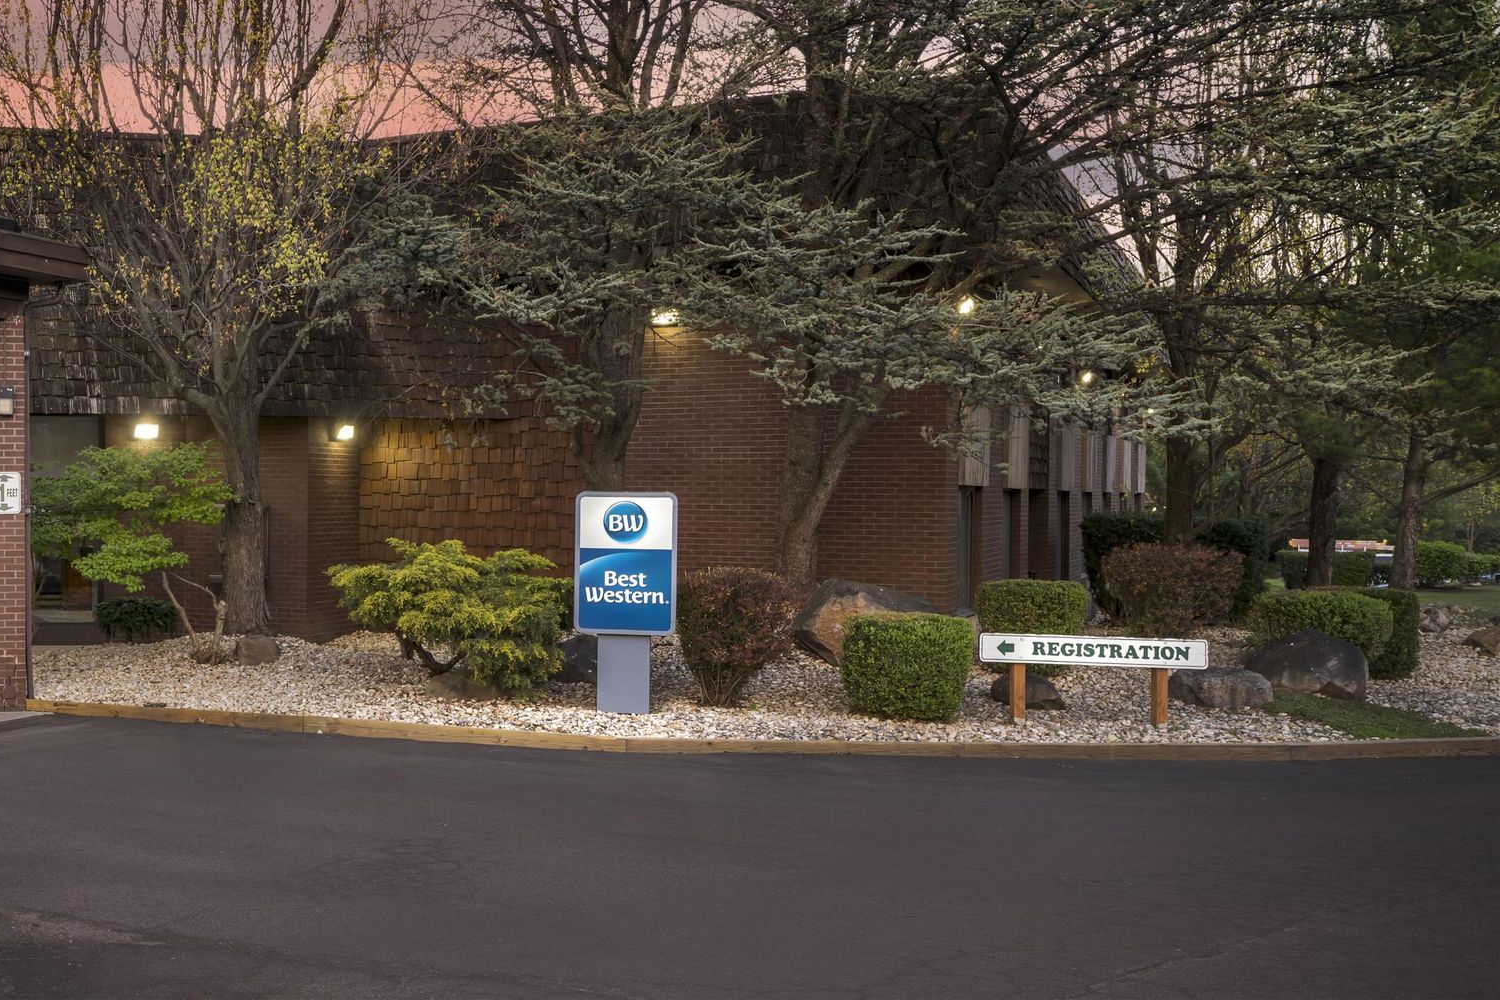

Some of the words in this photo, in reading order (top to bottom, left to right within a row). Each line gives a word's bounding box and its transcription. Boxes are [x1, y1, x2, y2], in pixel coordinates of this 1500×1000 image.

[7, 488, 18, 498] FEET
[608, 514, 644, 532] BW
[604, 570, 647, 587] Best
[1032, 641, 1190, 661] REGISTRATION
